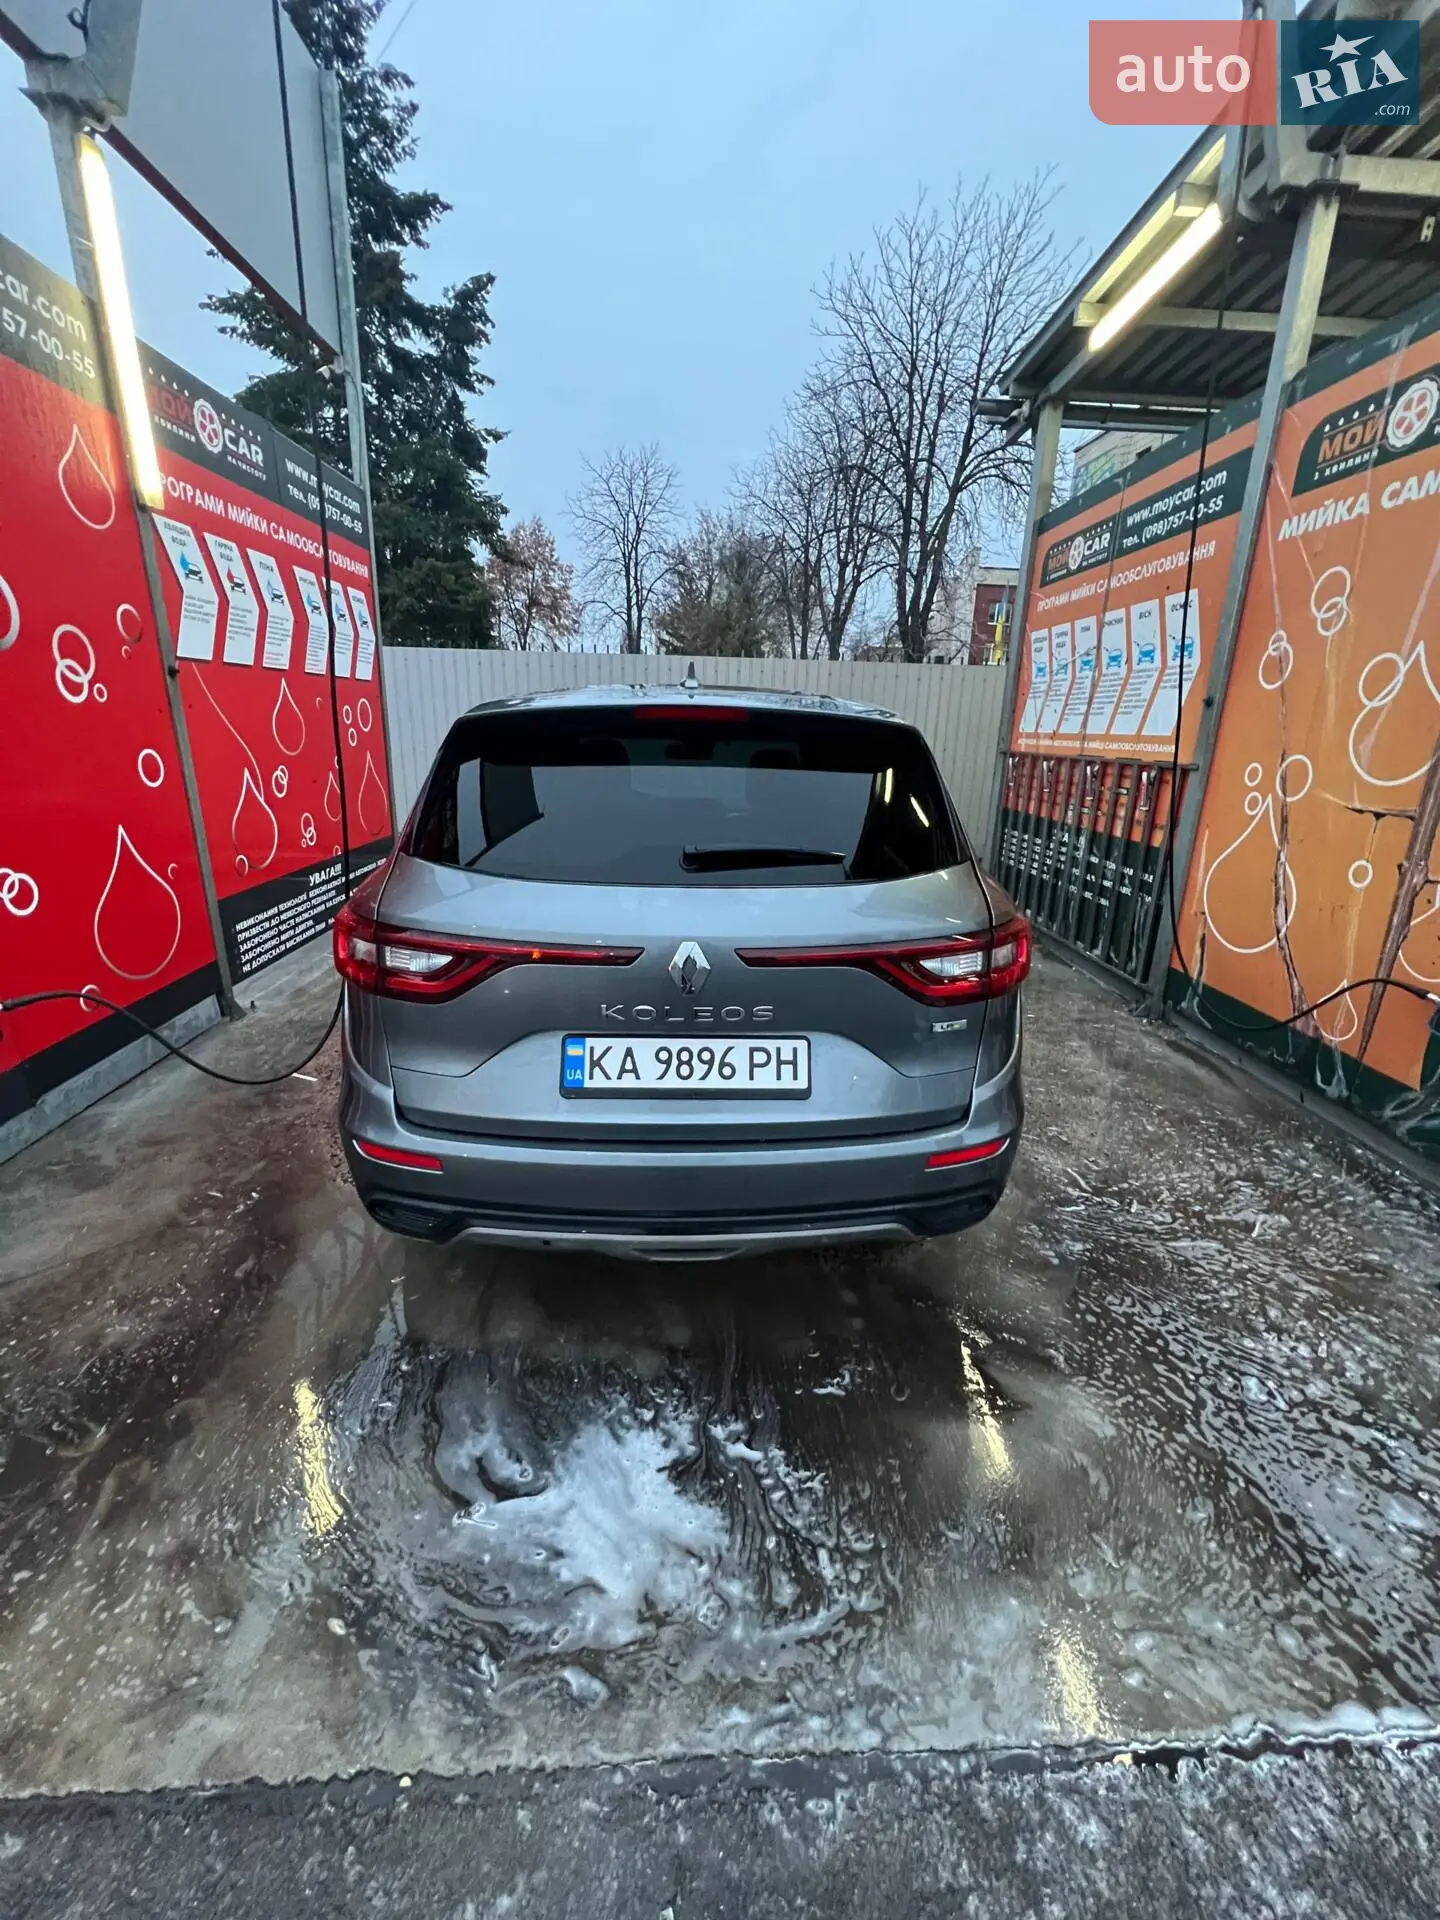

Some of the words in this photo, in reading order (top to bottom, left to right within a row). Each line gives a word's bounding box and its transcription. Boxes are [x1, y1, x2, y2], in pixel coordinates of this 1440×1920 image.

[2, 308, 96, 379] 57-00-55
[223, 427, 265, 467] CAR
[1317, 411, 1385, 463] МОЙ
[285, 458, 361, 514] www.mycar.com
[159, 471, 225, 516] РОГРАМИ
[227, 502, 268, 537] МИЙКИ
[270, 522, 369, 578] САМООБСЛГОВУВАННЯ
[307, 492, 363, 534] (09)757-00-55
[1278, 492, 1370, 541] МИЙКА
[1083, 532, 1110, 556] CAR
[1170, 600, 1193, 613] ОСМС
[270, 916, 280, 927] ДО
[239, 926, 278, 953] ЗАБОРОНЕНО
[240, 936, 280, 964] ЗАБОРОНЕНО
[242, 962, 252, 974] НЕ
[600, 1004, 775, 1022] KOLEOS
[566, 1069, 583, 1081] UA
[587, 1045, 642, 1081] KA
[653, 1045, 737, 1081] 9896
[747, 1045, 799, 1081] PH
